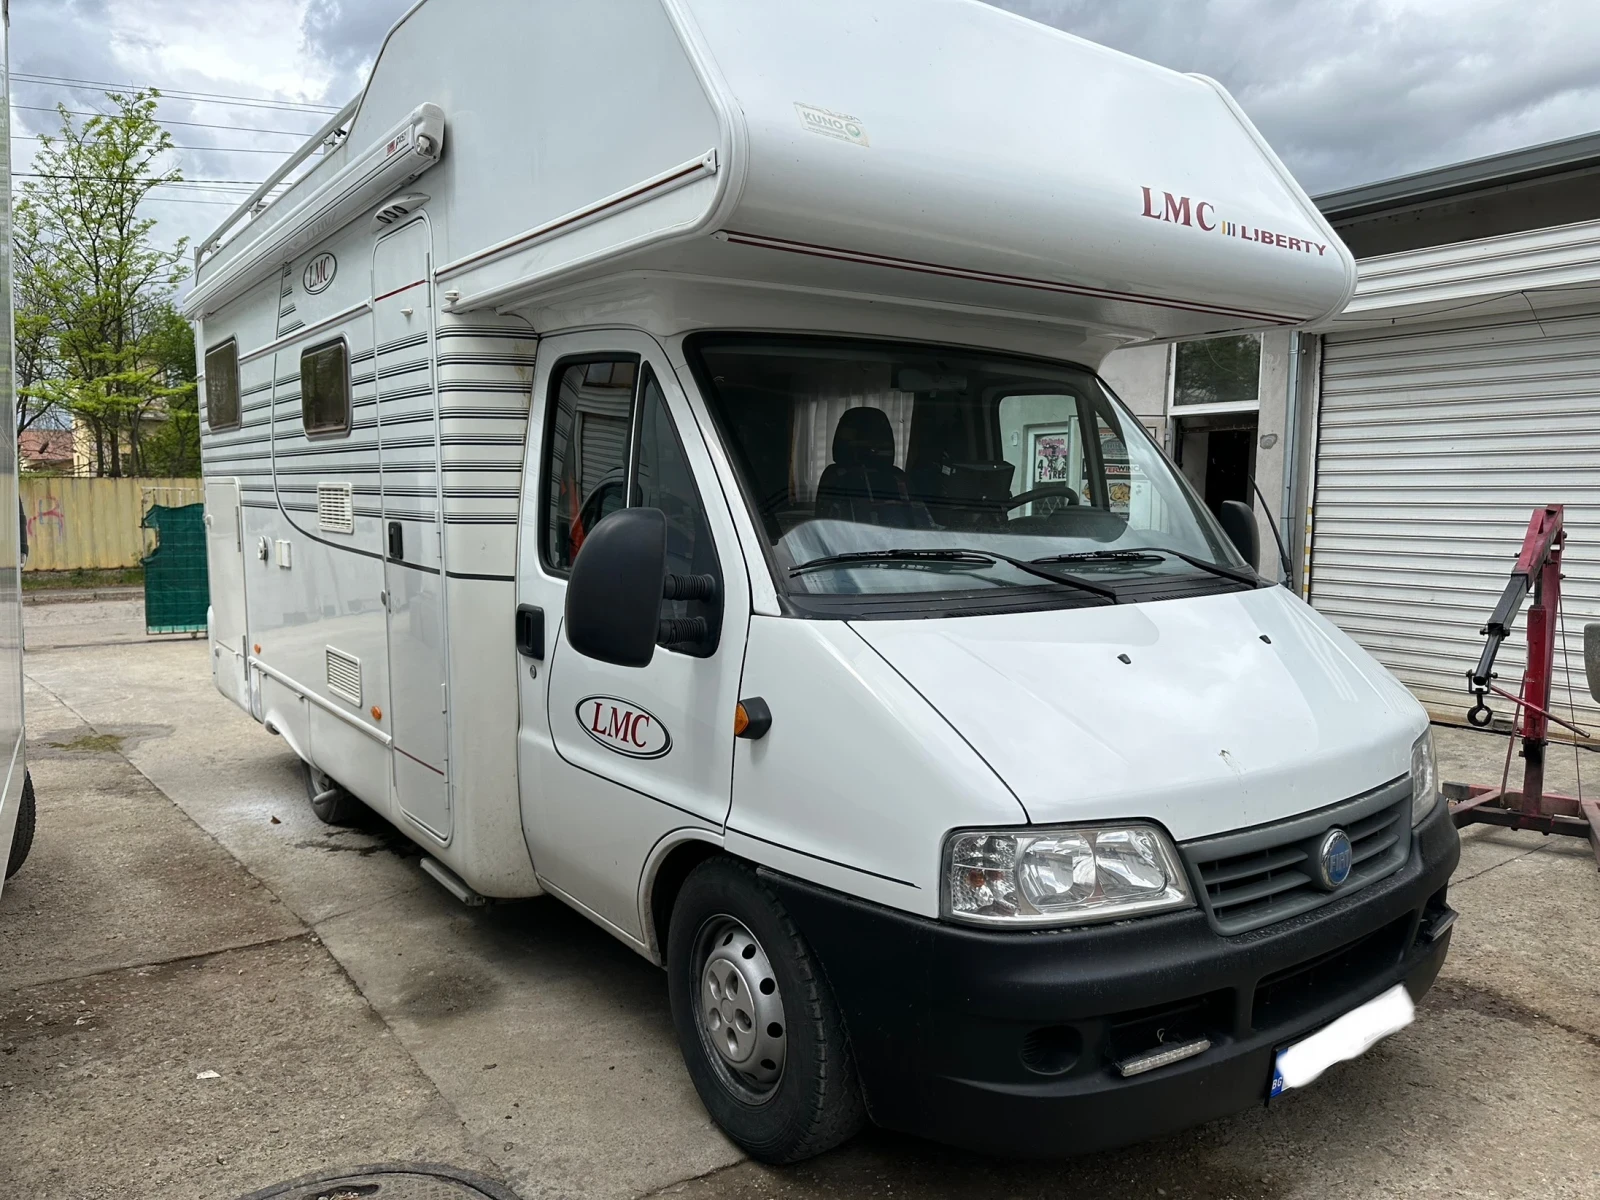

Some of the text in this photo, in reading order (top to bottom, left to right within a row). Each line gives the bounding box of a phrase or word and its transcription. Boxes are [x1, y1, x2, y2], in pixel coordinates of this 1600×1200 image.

[803, 111, 844, 129] KUNO
[1140, 186, 1326, 256] LMC LIBERTY
[309, 256, 330, 288] LMC
[591, 701, 650, 748] LMC
[1329, 849, 1350, 873] FIAT
[1272, 1076, 1283, 1091] BG
